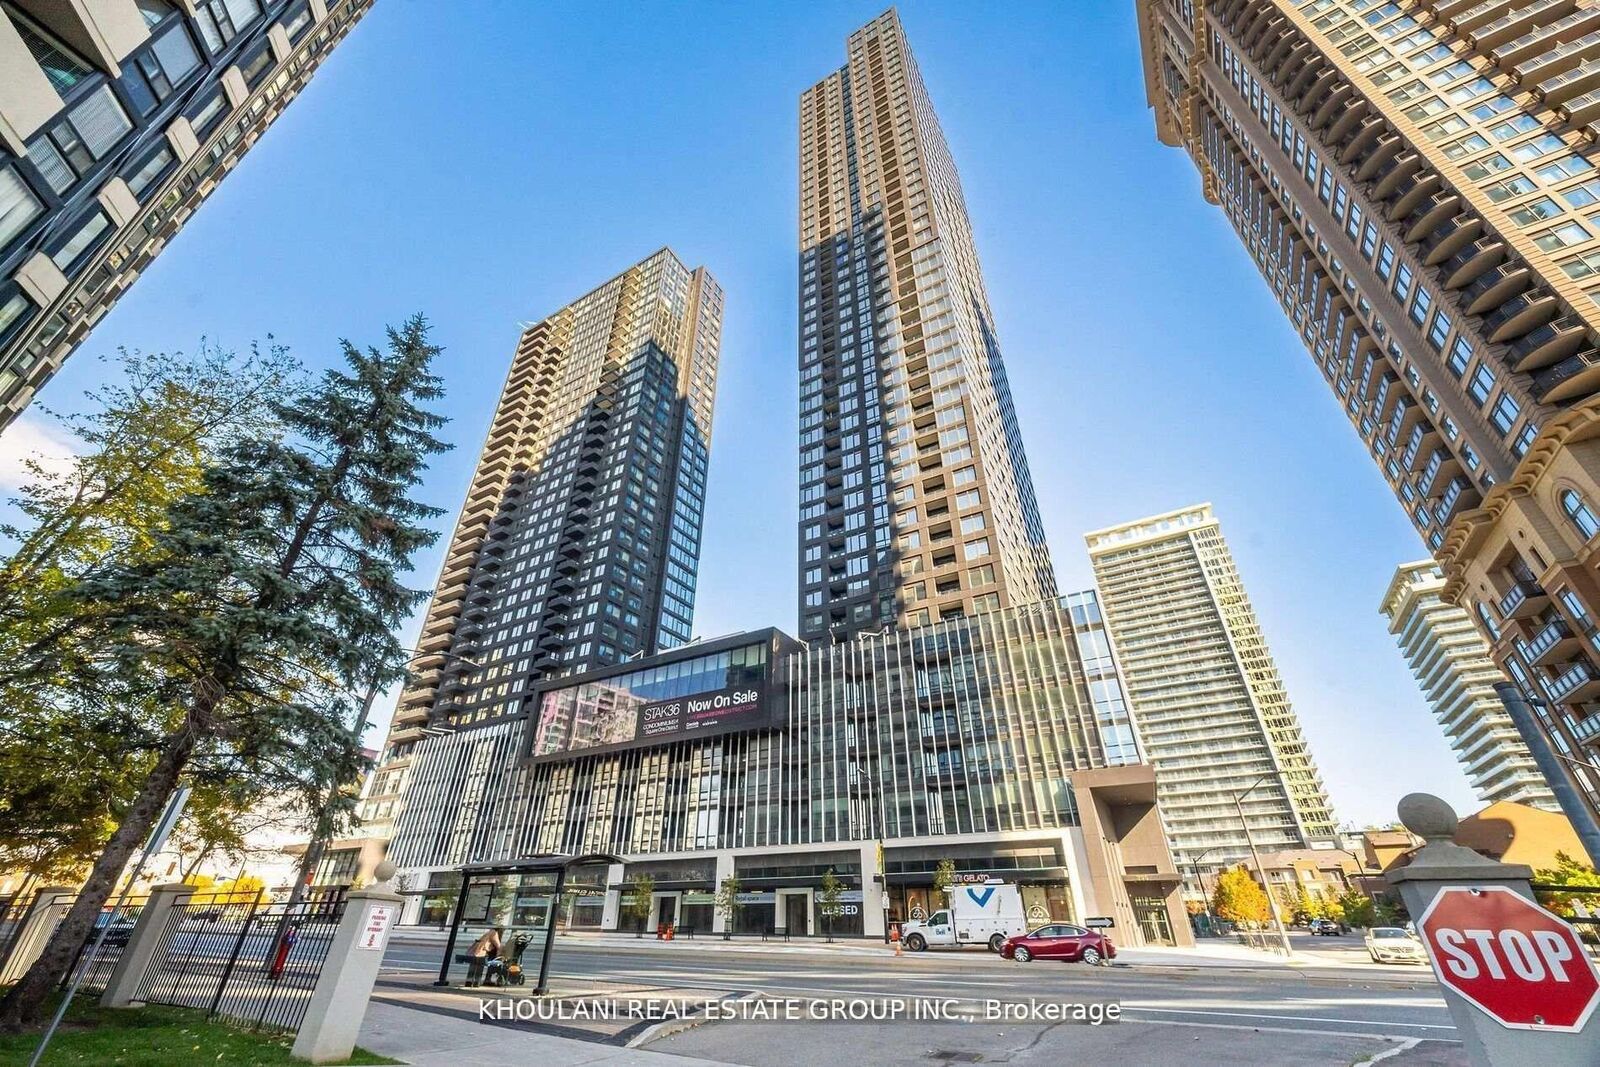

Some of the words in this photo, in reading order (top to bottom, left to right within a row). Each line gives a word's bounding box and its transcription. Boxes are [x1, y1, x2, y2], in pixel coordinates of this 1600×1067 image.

[687, 700, 712, 713] Now
[714, 695, 730, 708] On
[733, 689, 758, 704] Sale
[643, 703, 680, 721] STAK36
[963, 874, 990, 882] GELATO
[935, 927, 946, 935] Bell
[1435, 928, 1573, 982] STOP
